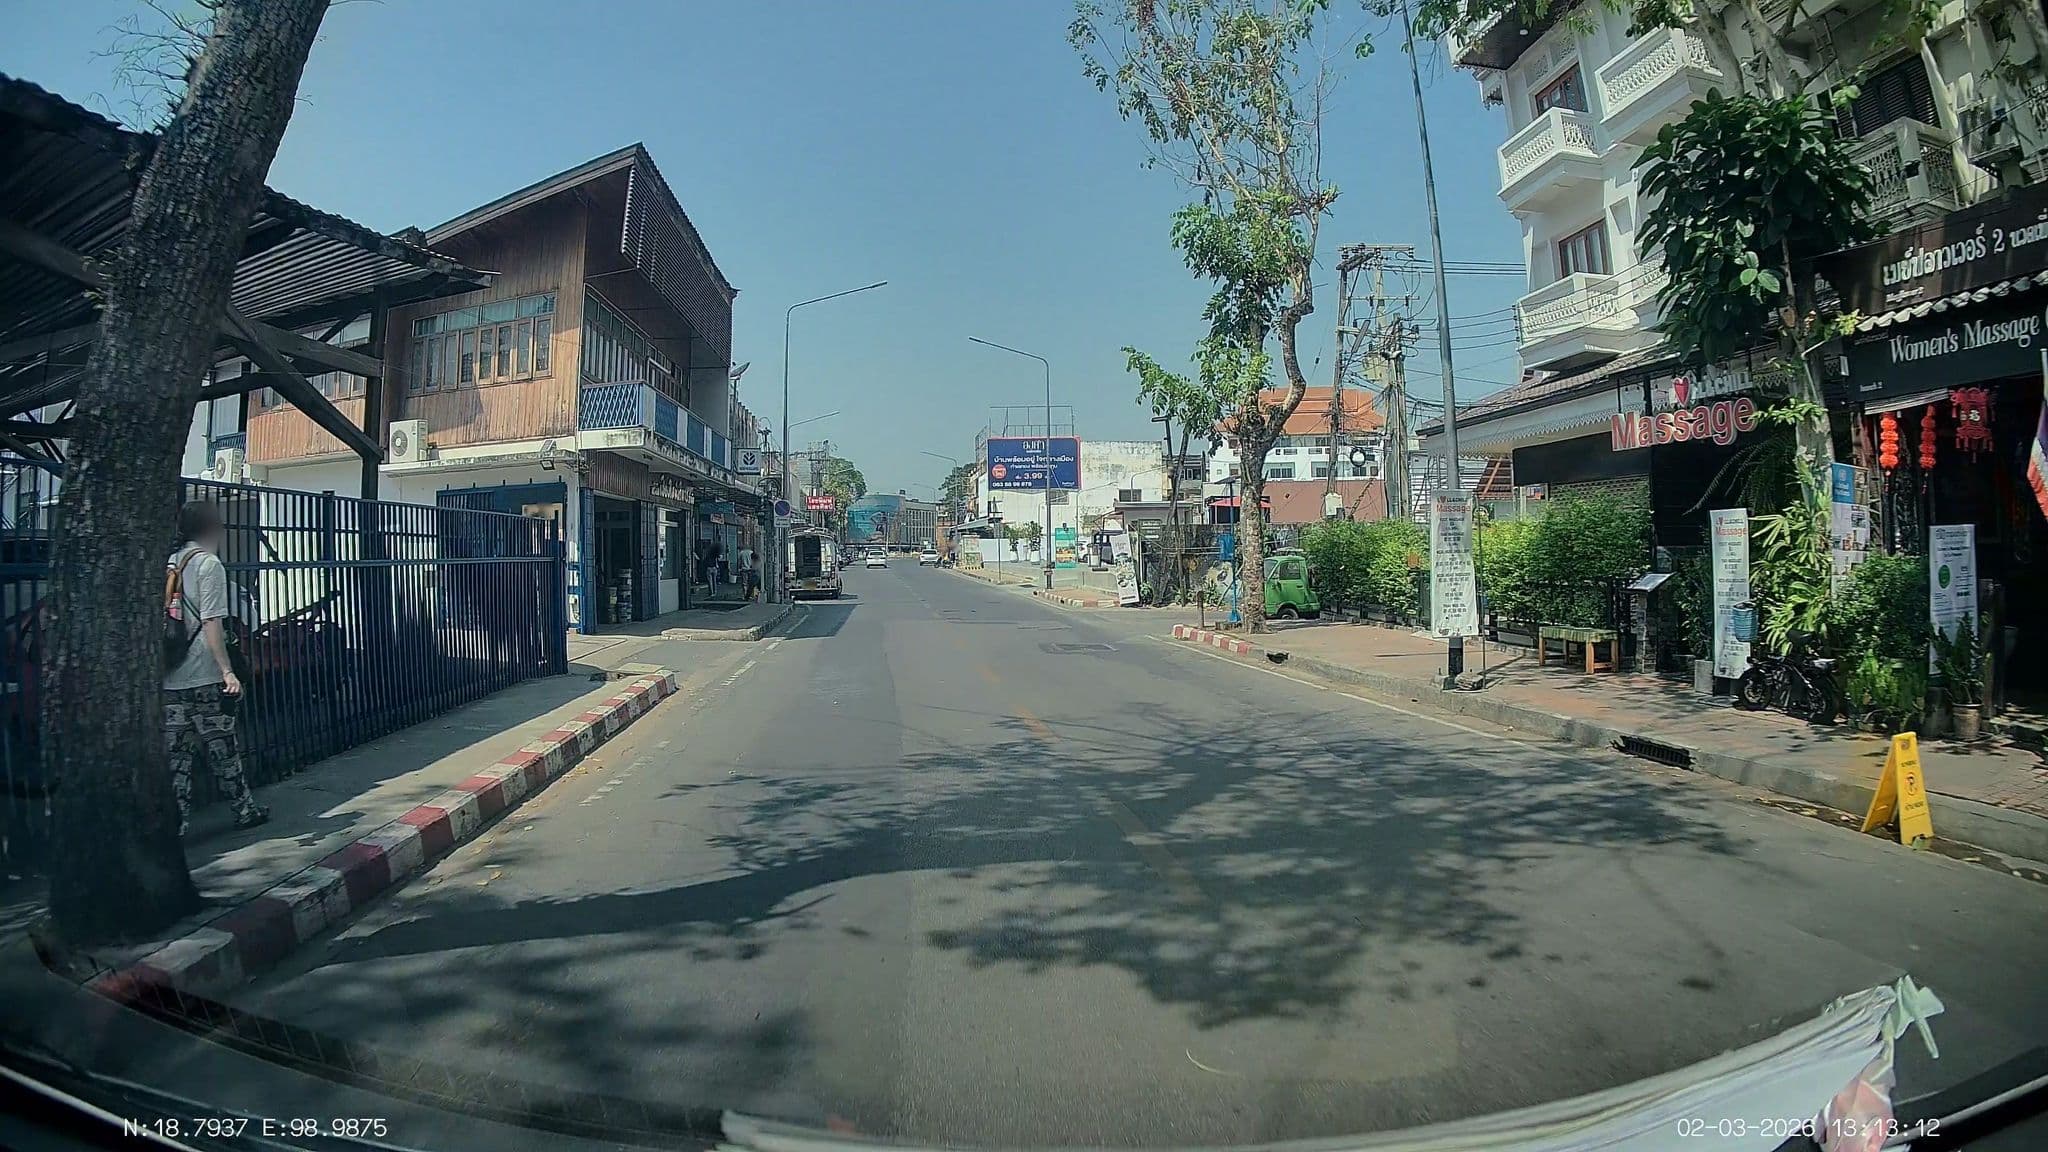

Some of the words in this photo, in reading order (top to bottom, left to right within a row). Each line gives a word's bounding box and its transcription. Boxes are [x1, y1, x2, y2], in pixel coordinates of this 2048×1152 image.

[1993, 228, 2006, 254] 2
[1890, 329, 1959, 364] Women's
[1961, 315, 2041, 349] Massage
[1611, 397, 1757, 452] Massage
[1023, 472, 1043, 480] 3.99
[1436, 504, 1471, 514] Massage
